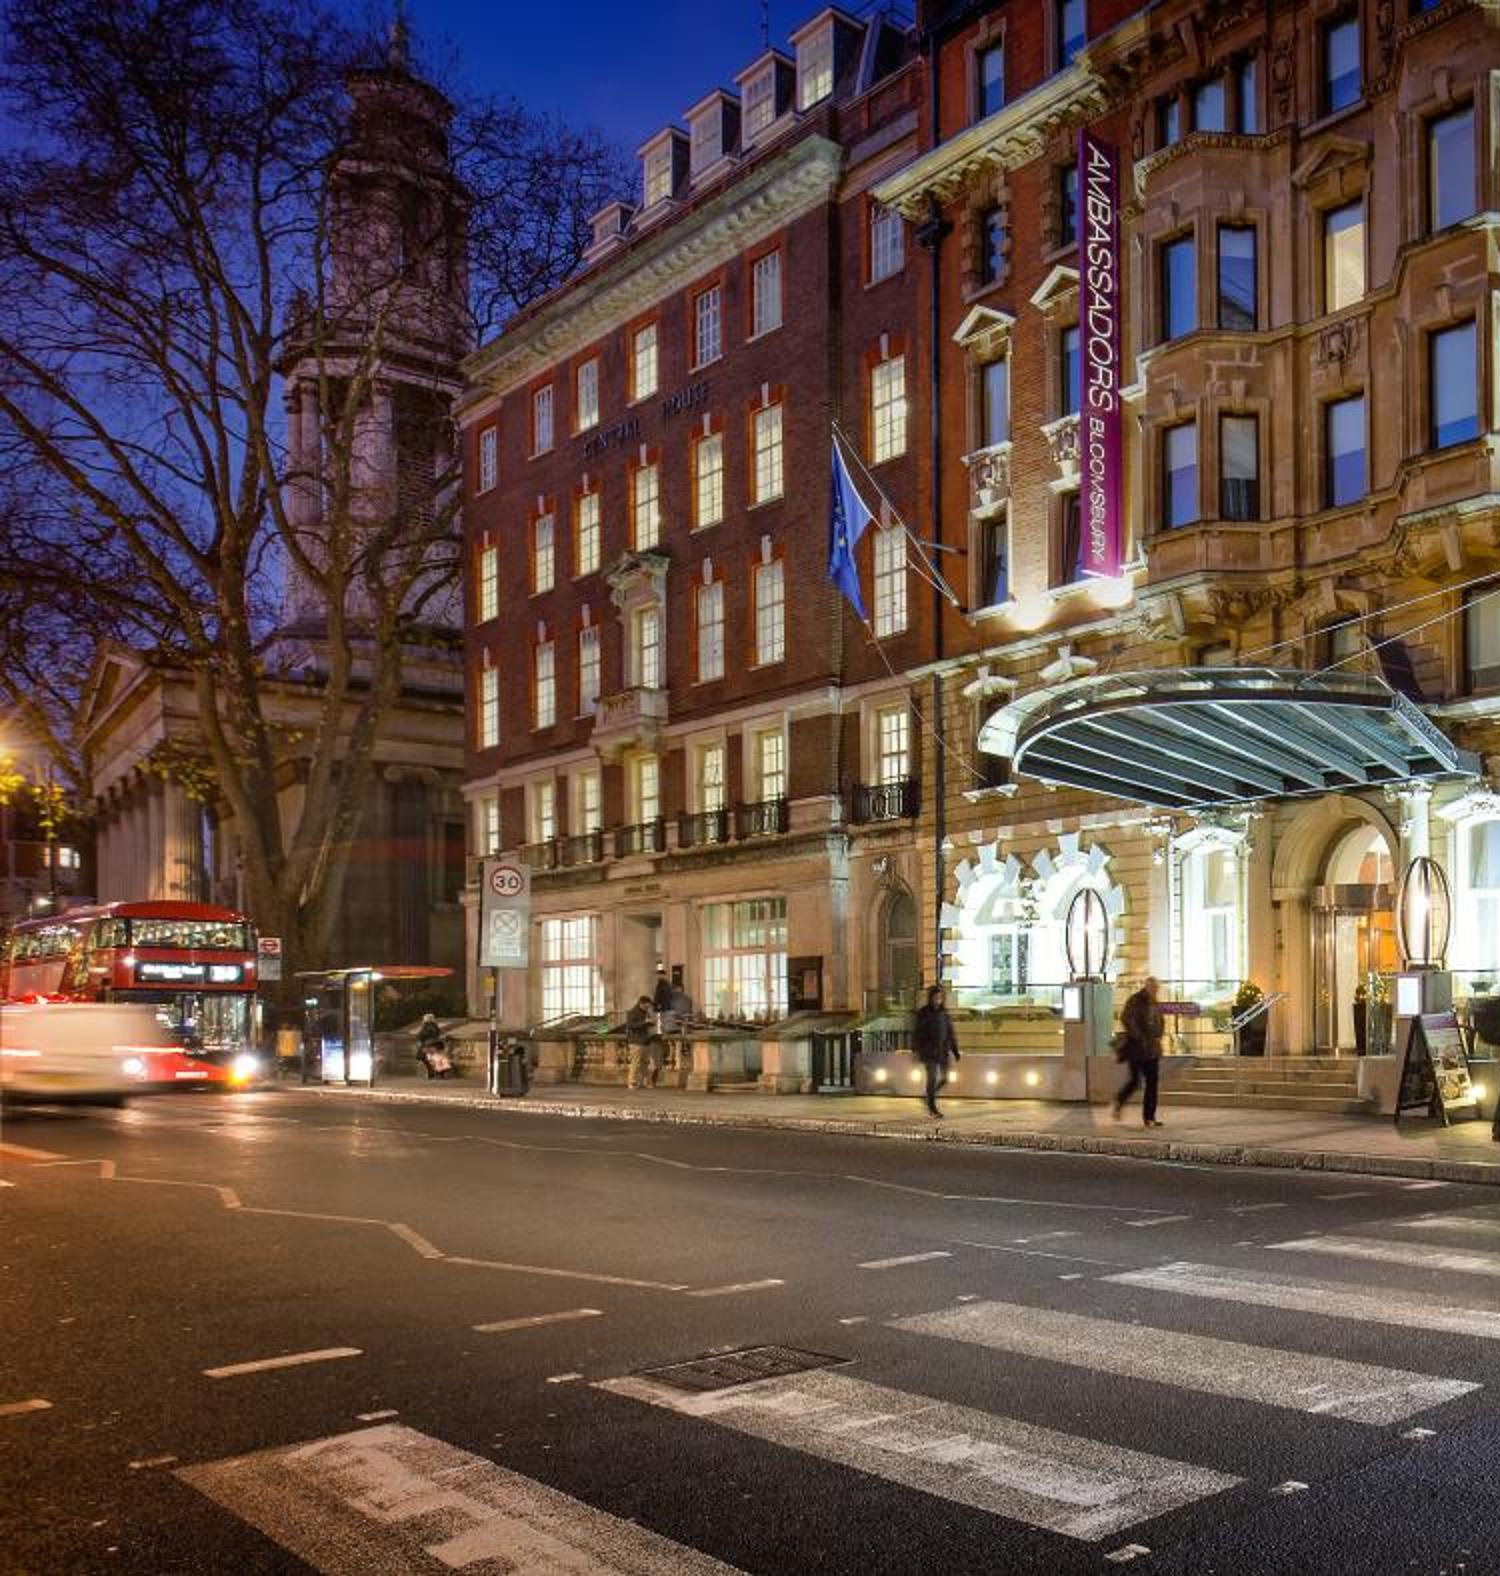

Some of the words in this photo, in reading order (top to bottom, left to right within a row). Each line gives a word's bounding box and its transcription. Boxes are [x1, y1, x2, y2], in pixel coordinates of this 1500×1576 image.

[1087, 140, 1114, 412] AMBASSADORS
[1089, 417, 1106, 562] BLOOMSBURY
[495, 875, 519, 889] 30
